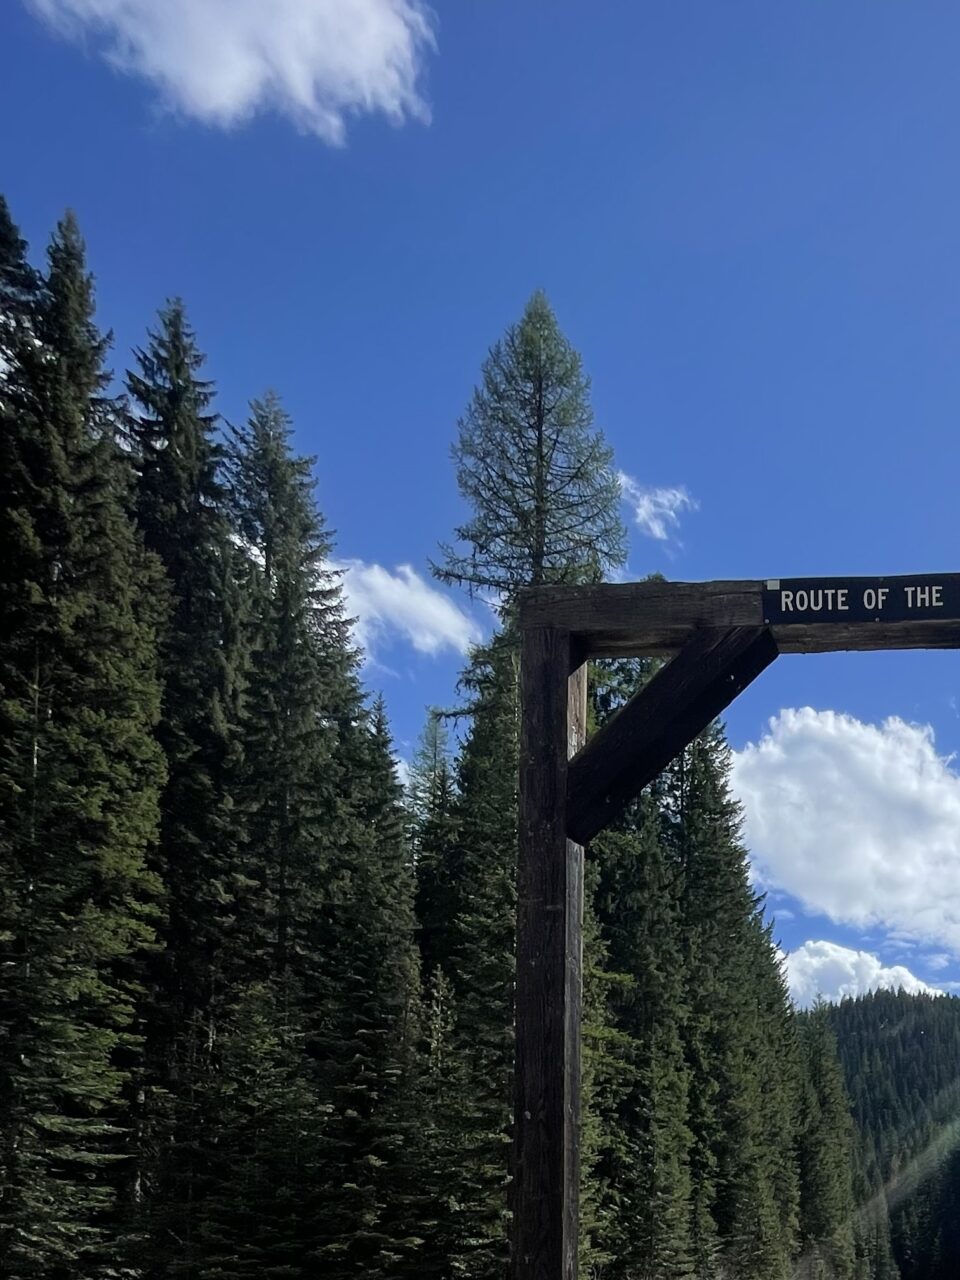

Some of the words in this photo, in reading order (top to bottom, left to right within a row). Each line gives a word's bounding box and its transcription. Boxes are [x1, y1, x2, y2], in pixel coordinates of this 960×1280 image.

[781, 589, 849, 611] ROUTE
[863, 588, 890, 610] OF
[904, 586, 943, 608] THE
